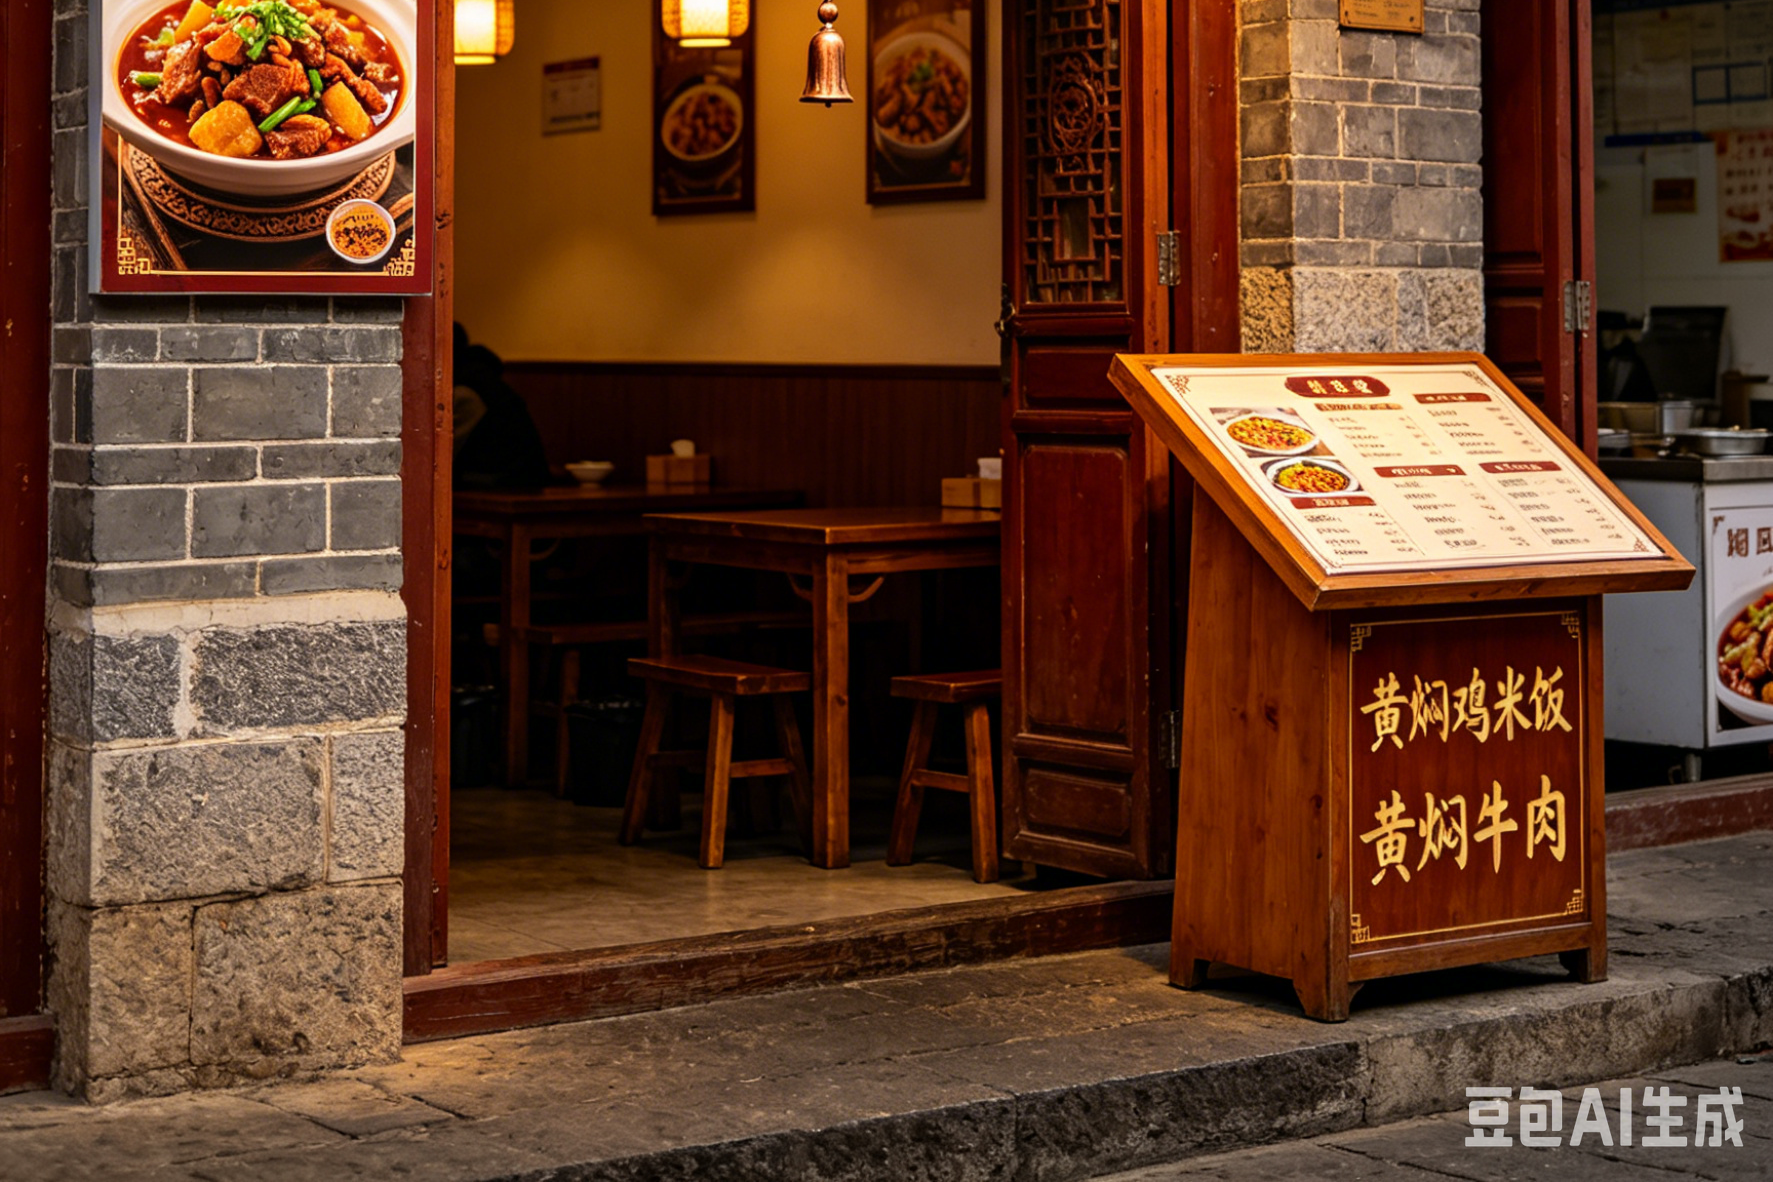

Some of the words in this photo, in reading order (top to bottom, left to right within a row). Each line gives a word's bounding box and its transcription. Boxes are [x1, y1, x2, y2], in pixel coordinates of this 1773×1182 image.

[1360, 666, 1573, 753] 黄焖鸡米饭
[1359, 774, 1566, 886] 黄焖牛肉
